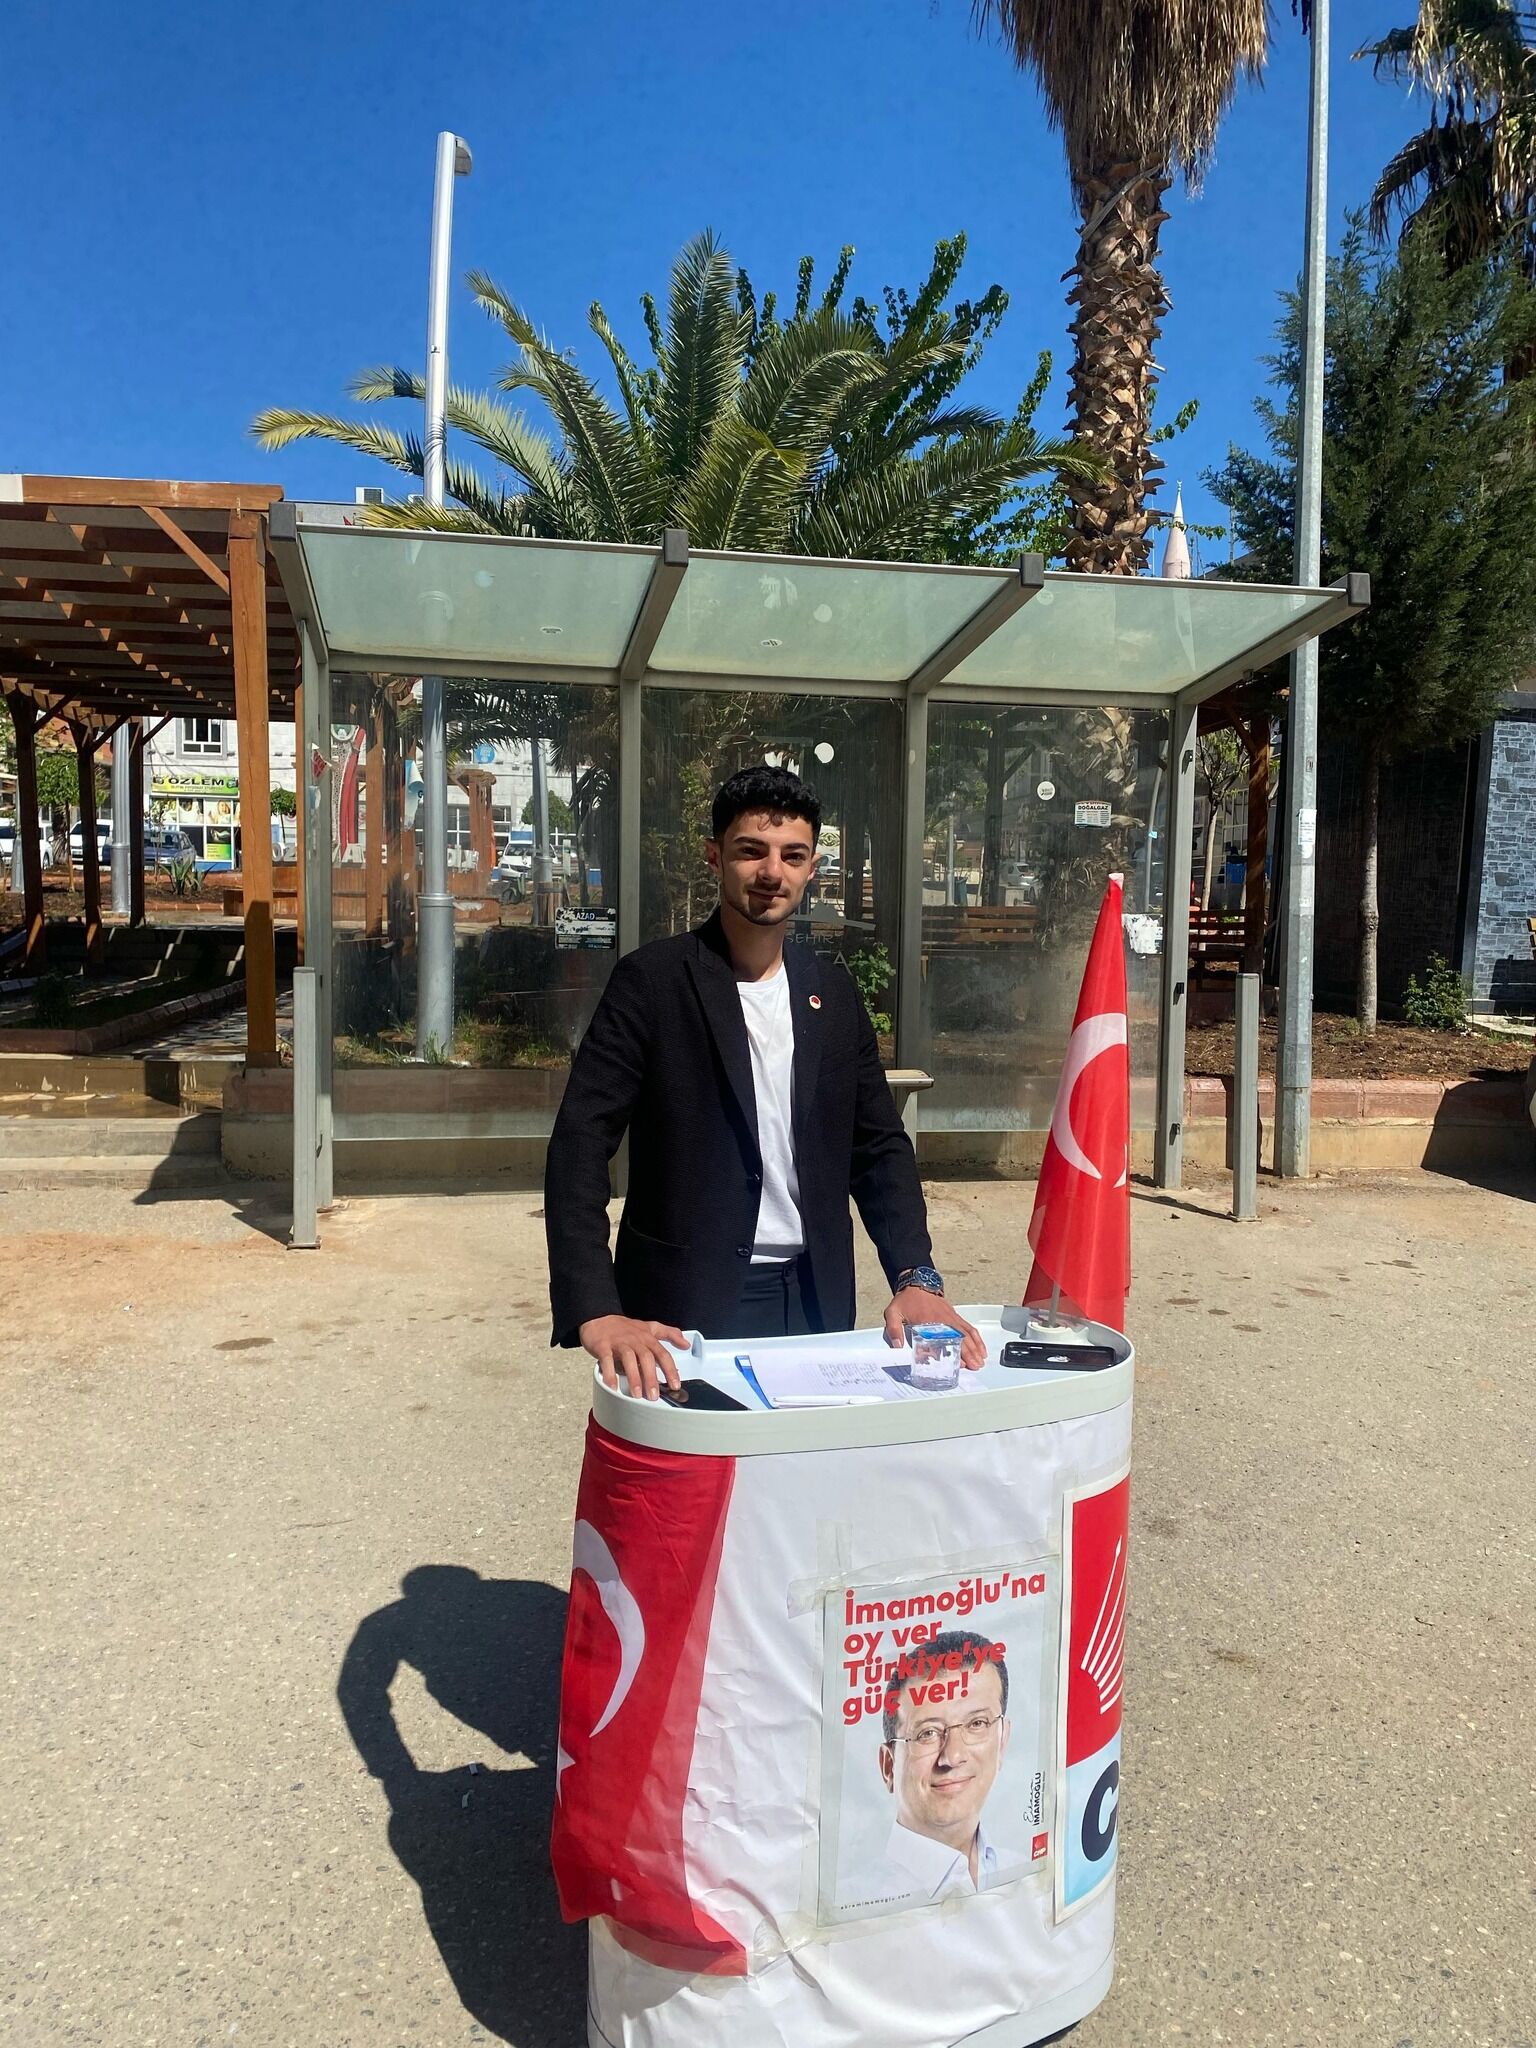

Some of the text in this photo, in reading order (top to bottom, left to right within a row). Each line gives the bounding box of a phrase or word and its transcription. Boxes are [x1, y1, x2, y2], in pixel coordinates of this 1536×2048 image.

[845, 1573, 1045, 1625] İmamoğlu'na
[843, 1640, 1006, 1687] Türkiye'ye
[844, 1620, 942, 1660] oy ver
[842, 1671, 969, 1725] güç ver!
[1082, 1760, 1119, 1861] C
